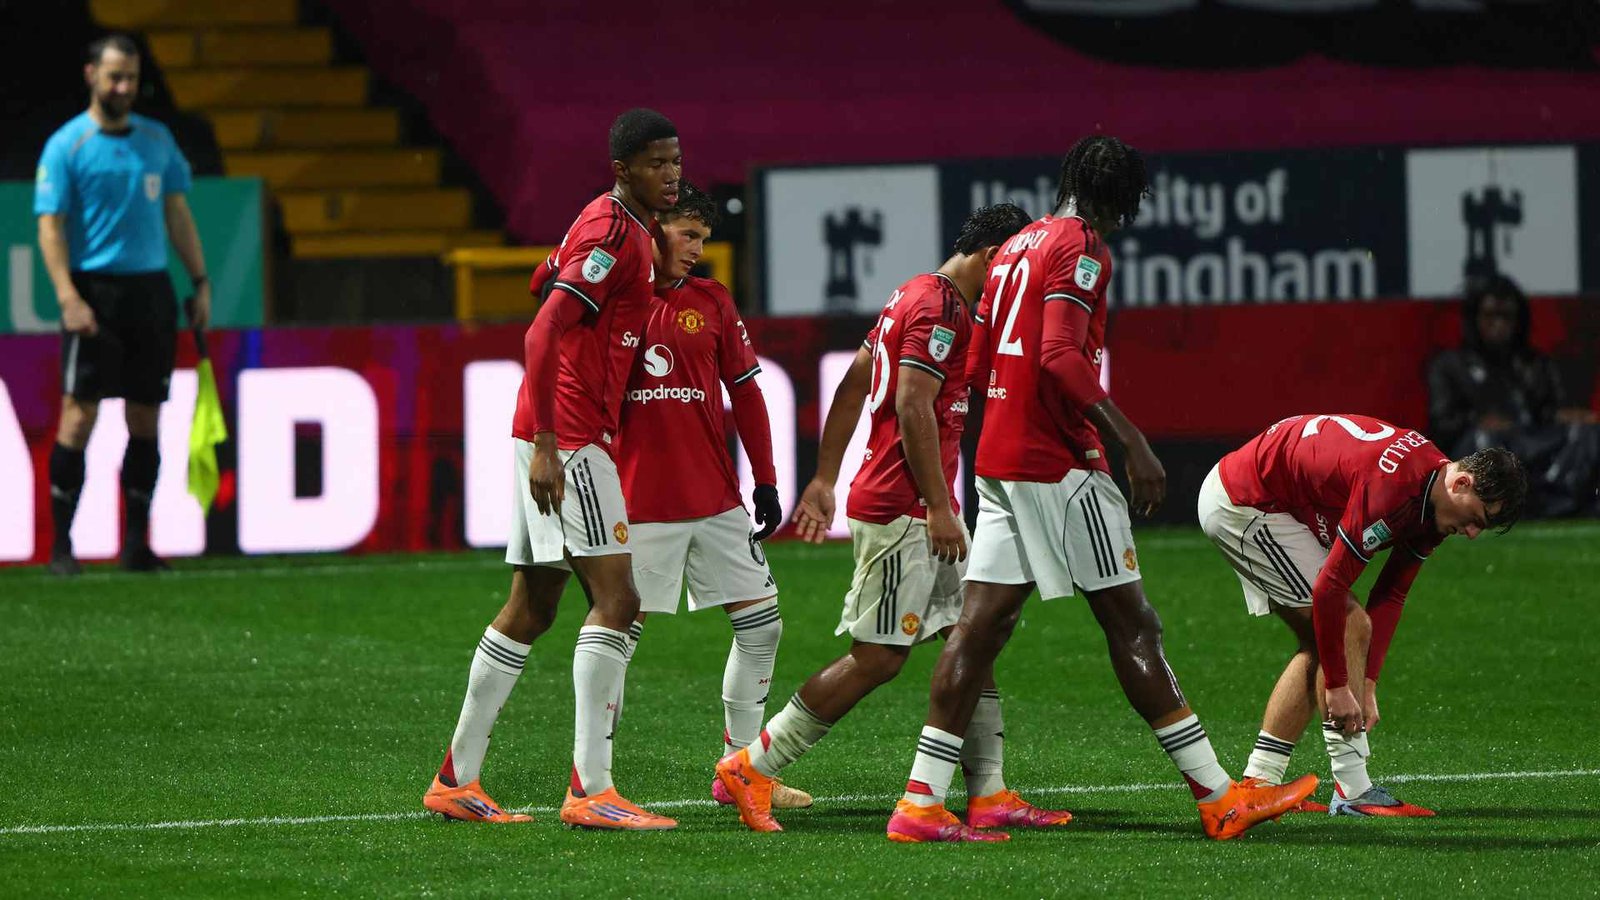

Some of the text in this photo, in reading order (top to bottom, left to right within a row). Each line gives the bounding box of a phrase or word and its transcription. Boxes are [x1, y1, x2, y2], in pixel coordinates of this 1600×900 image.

[970, 169, 1288, 240] Unisity of
[990, 256, 1024, 356] 72
[1108, 237, 1376, 305] ingham
